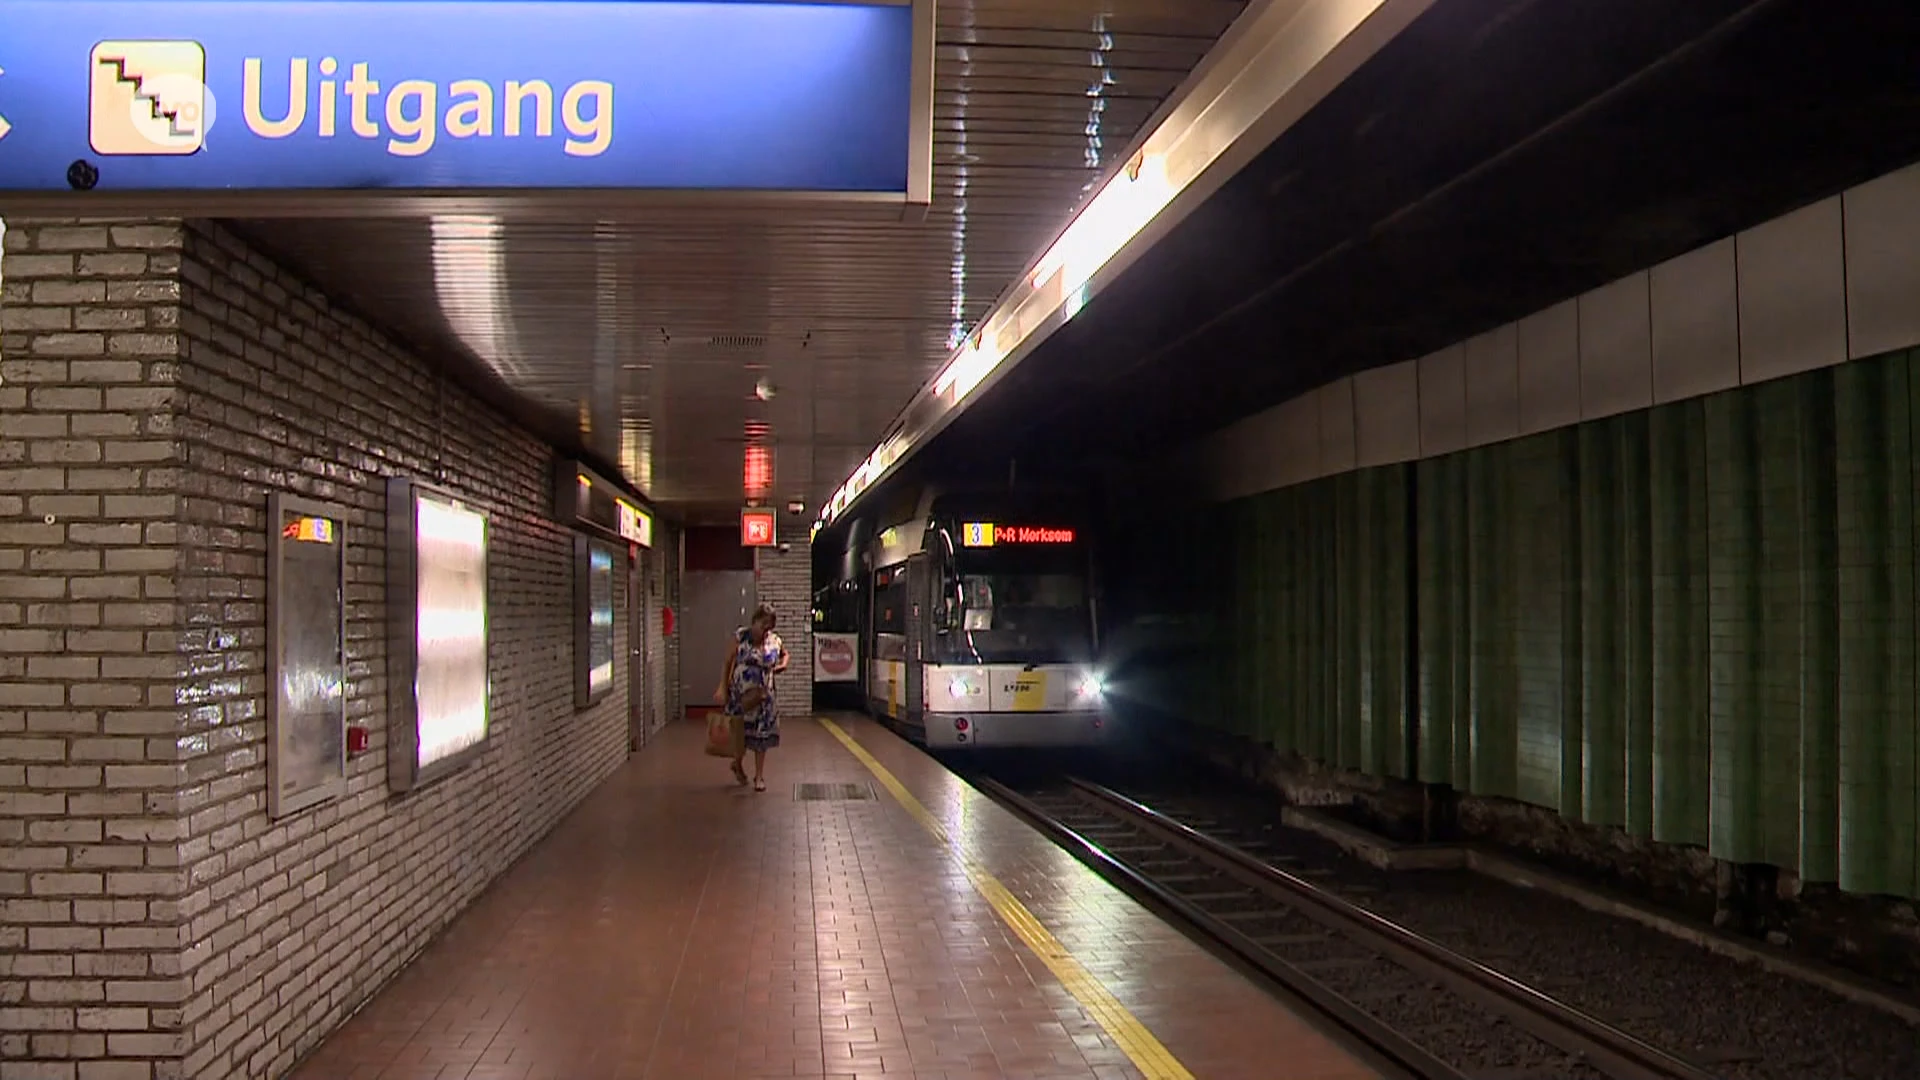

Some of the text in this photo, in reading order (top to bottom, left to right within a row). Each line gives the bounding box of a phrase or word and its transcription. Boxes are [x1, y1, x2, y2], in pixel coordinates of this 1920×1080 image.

[242, 56, 613, 157] Uitgang
[971, 523, 981, 544] 3
[994, 527, 1016, 542] P+R
